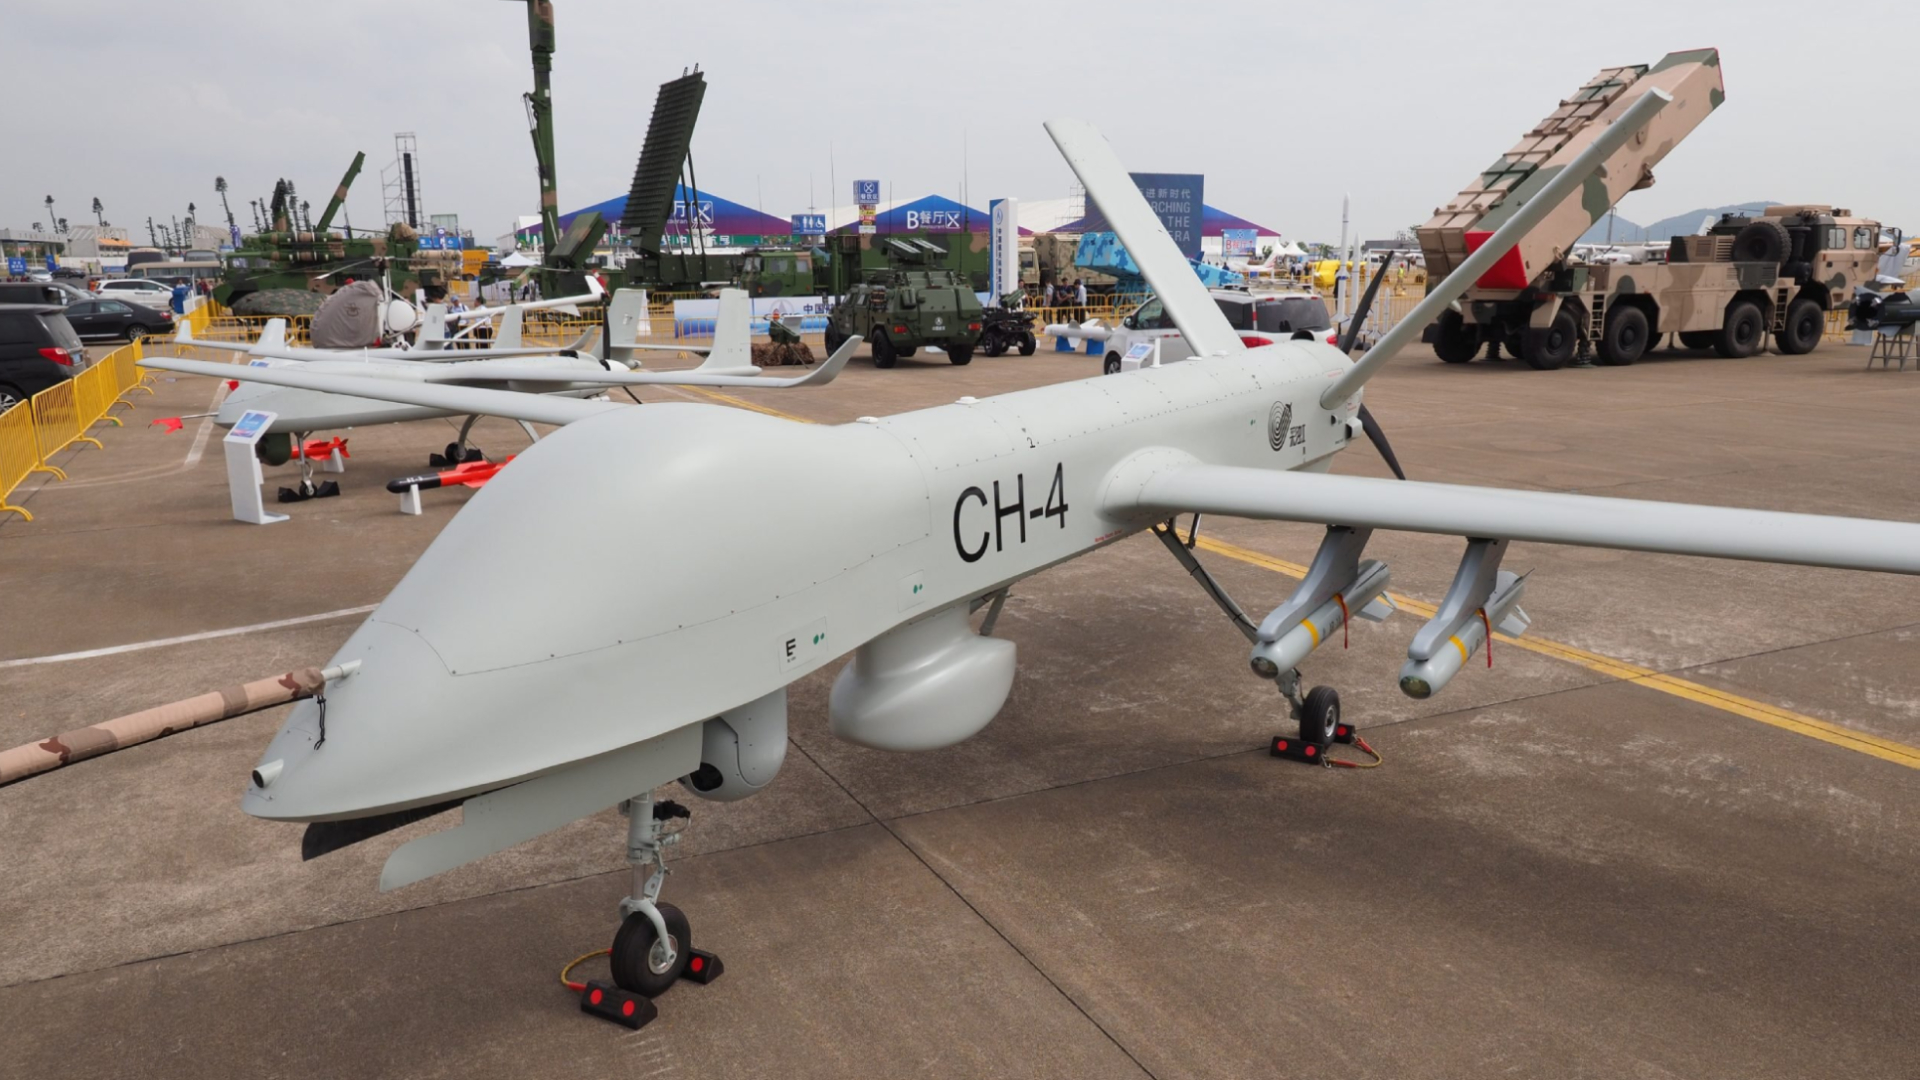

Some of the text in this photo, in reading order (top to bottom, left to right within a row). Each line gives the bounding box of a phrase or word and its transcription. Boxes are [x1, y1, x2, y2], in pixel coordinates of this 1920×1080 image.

[1141, 188, 1191, 199] 进新时代
[1151, 201, 1191, 214] RCHING
[1167, 216, 1190, 228] THE
[953, 461, 1069, 563] CH-4
